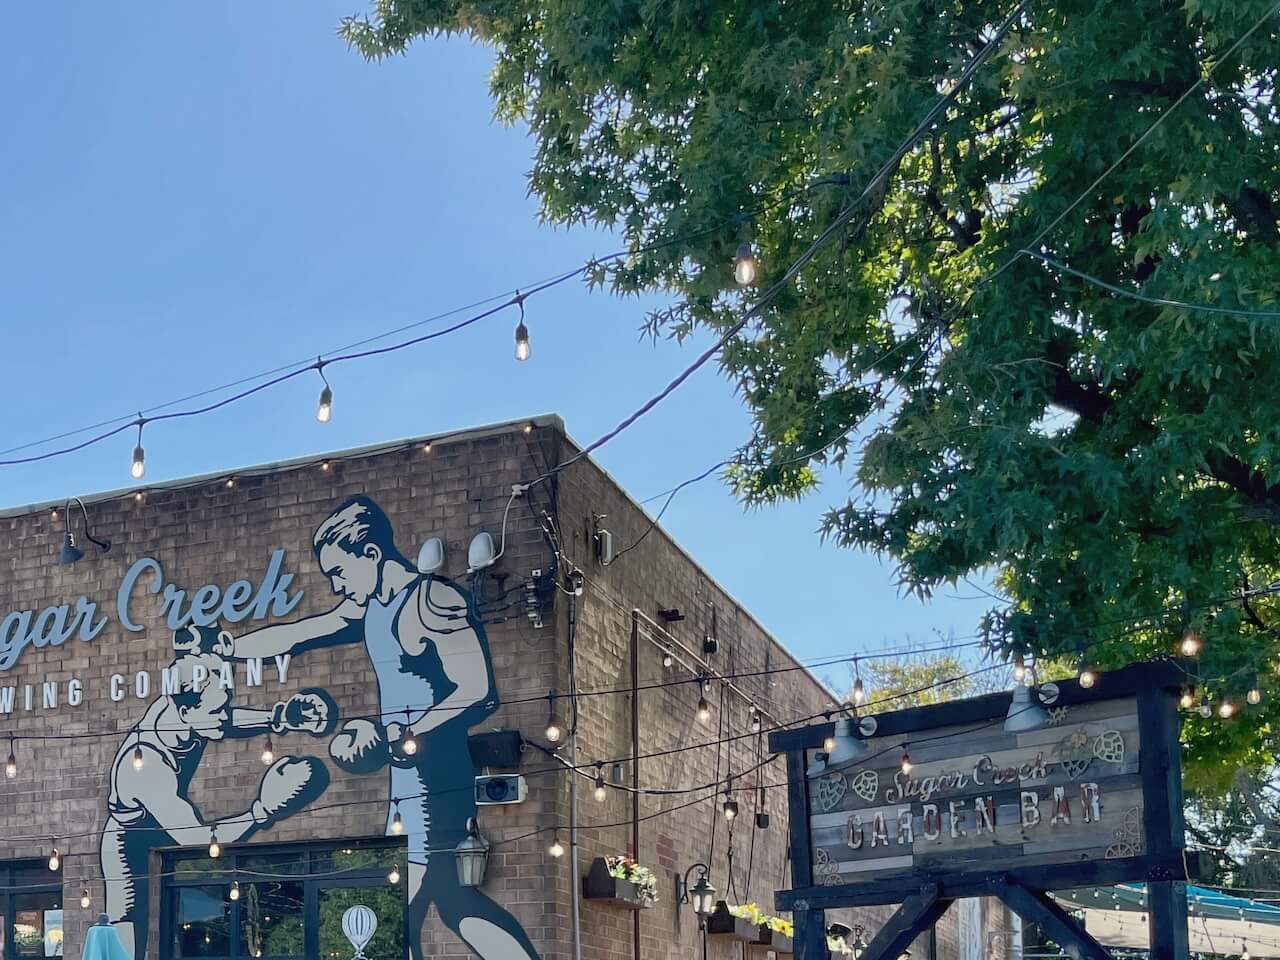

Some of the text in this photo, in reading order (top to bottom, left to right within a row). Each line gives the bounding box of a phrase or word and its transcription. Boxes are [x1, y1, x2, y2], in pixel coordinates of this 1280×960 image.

[117, 549, 305, 632] Creek
[110, 653, 292, 703] COMPANY
[885, 750, 1051, 804] Sugar Creek
[847, 782, 1101, 850] GARDEN BAR
